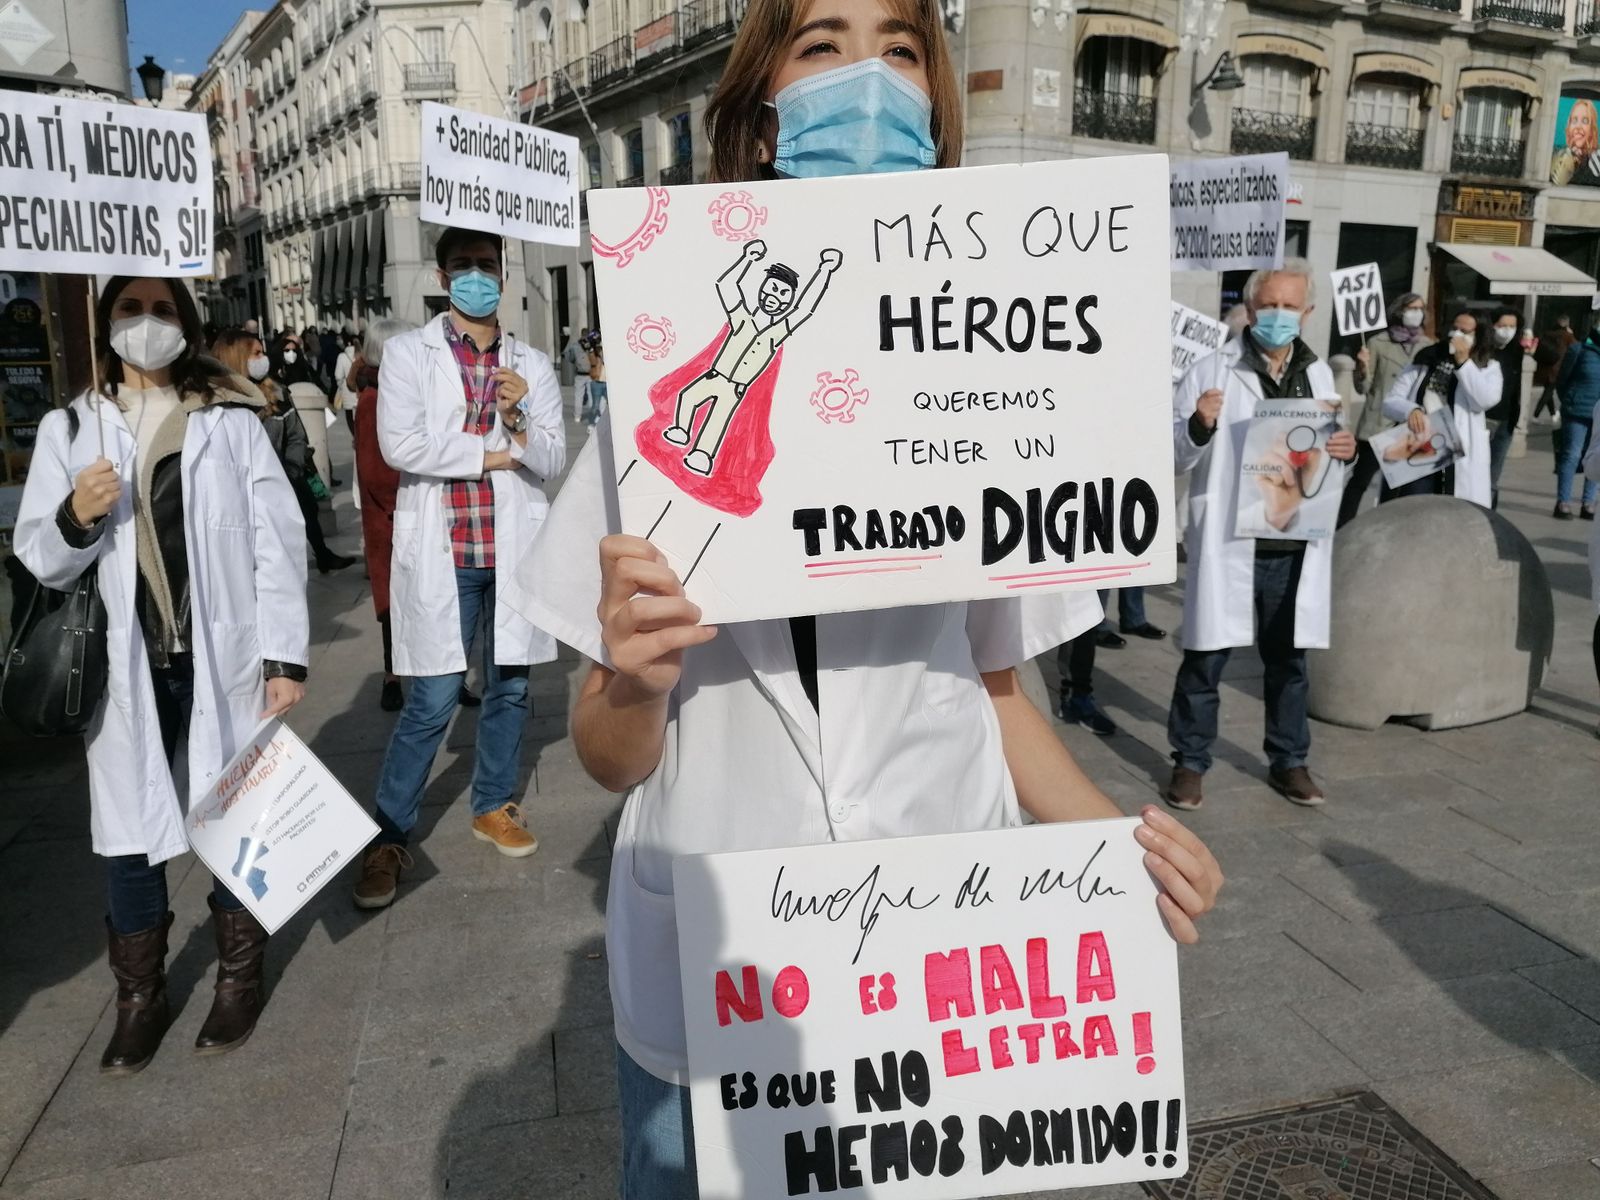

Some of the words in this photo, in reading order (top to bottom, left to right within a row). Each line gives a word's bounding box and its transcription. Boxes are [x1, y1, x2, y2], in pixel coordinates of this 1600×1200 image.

[37, 105, 76, 183] TÍ,
[82, 111, 197, 184] MÉDICOS
[450, 114, 510, 163] Sanidad
[515, 131, 571, 184] Pública,
[426, 165, 454, 216] hoy
[459, 175, 490, 214] más
[495, 190, 521, 226] que
[526, 196, 575, 230] nunca!
[0, 195, 170, 266] PECIALISTAS,
[178, 197, 207, 258] SÍ!
[874, 203, 987, 262] MÁS
[1022, 204, 1134, 258] QUE
[1210, 232, 1242, 259] causa
[1337, 264, 1375, 296] ASÍ
[1344, 292, 1381, 331] NO
[879, 279, 1103, 355] HÉROES
[913, 387, 1056, 413] QUEREMOS
[1268, 410, 1318, 419] HACEMOS
[884, 437, 988, 465] TENER
[1014, 433, 1056, 460] UN
[792, 504, 966, 557] TRABAJO
[981, 477, 1160, 566] DIGNO
[714, 963, 810, 1027] NO
[858, 970, 898, 1015] ES
[923, 929, 1117, 1022] MALA
[941, 1012, 1157, 1077] LETRA!
[720, 1070, 759, 1111] ES
[767, 1069, 837, 1109] QUE
[854, 1049, 931, 1114] NO
[784, 1114, 966, 1197] HEMOS
[978, 1098, 1181, 1176] DORMIDO!!
